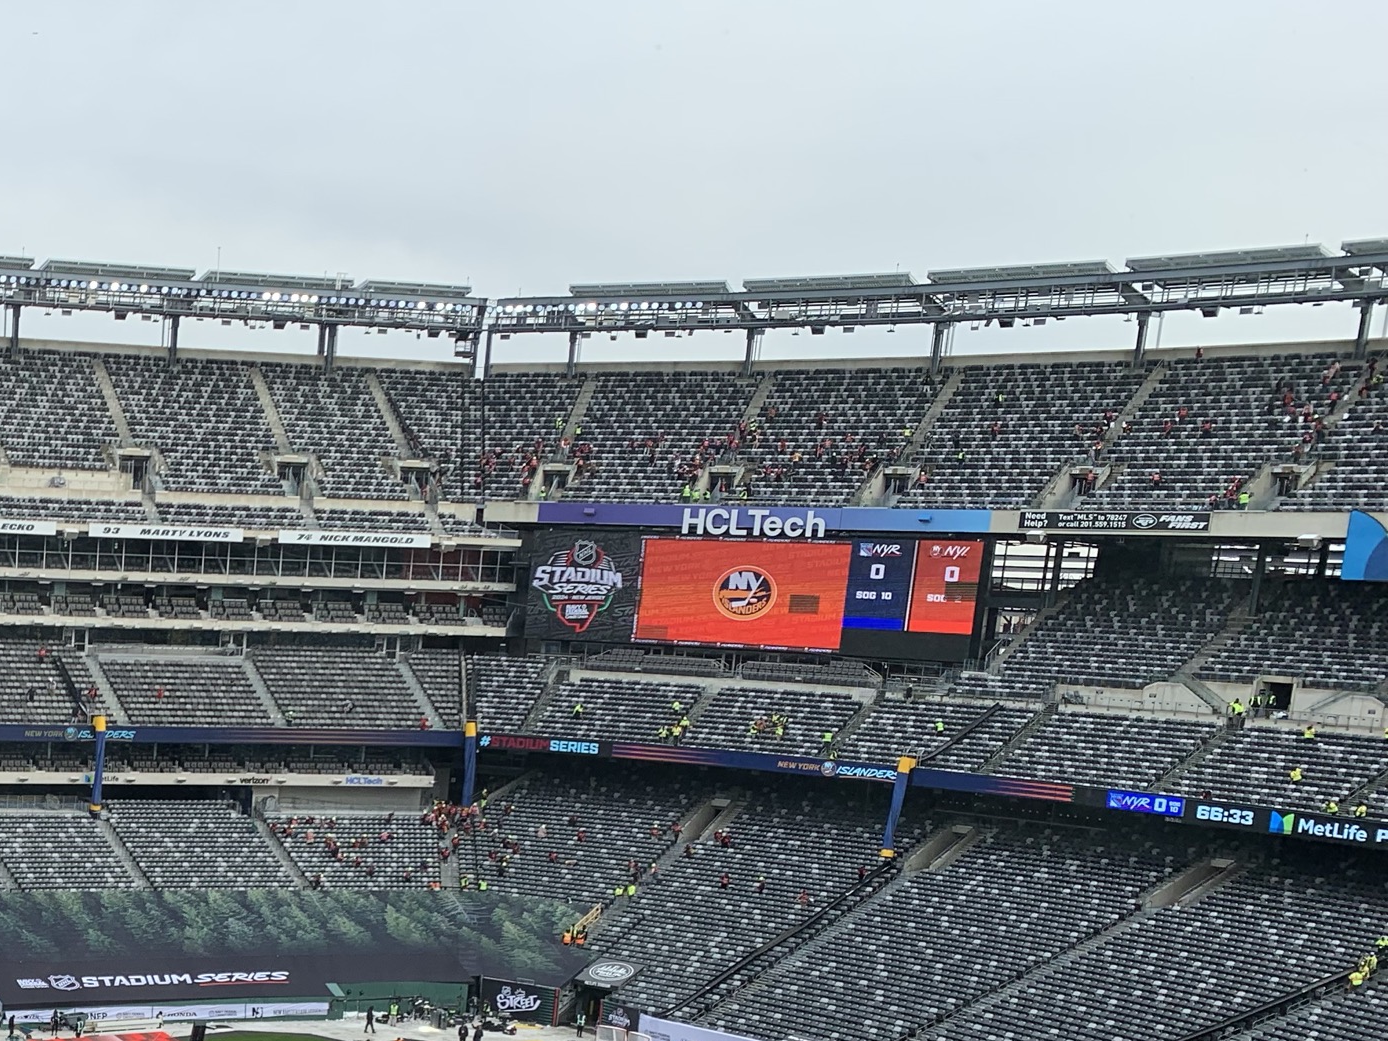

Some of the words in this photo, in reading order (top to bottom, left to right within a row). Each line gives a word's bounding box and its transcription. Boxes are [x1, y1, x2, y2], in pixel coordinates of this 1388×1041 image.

[1025, 512, 1046, 520] Need
[1159, 514, 1194, 522] FANS
[681, 508, 826, 538] HCLTech
[1024, 520, 1048, 528] Help?
[1066, 520, 1079, 528] call
[1168, 521, 1209, 530] FIRST
[102, 526, 121, 535] 93
[140, 528, 187, 538] MARTY
[188, 529, 231, 539] LYONS
[319, 534, 351, 543] NICK
[351, 535, 415, 545] MANGOLD
[873, 544, 901, 557] NYR
[944, 545, 971, 560] NYI
[532, 566, 623, 588] STADIUM
[870, 563, 885, 579] 0
[945, 566, 960, 582] 0
[548, 583, 611, 595] SERIES
[855, 590, 876, 600] SOG
[881, 591, 892, 600] 10
[721, 597, 767, 615] ISLANDERS
[43, 730, 63, 738] YORK
[77, 730, 136, 739] ISDERS
[777, 760, 796, 769] NEW
[798, 762, 820, 771] YORK
[345, 777, 383, 785] HCLTech
[1122, 795, 1151, 810] NYR
[1154, 798, 1166, 812] 0
[1196, 805, 1254, 825] 66:33
[1298, 818, 1368, 842] MetLife
[81, 974, 192, 988] STADIUM
[194, 971, 290, 983] SERIES
[497, 993, 541, 1011] STREET
